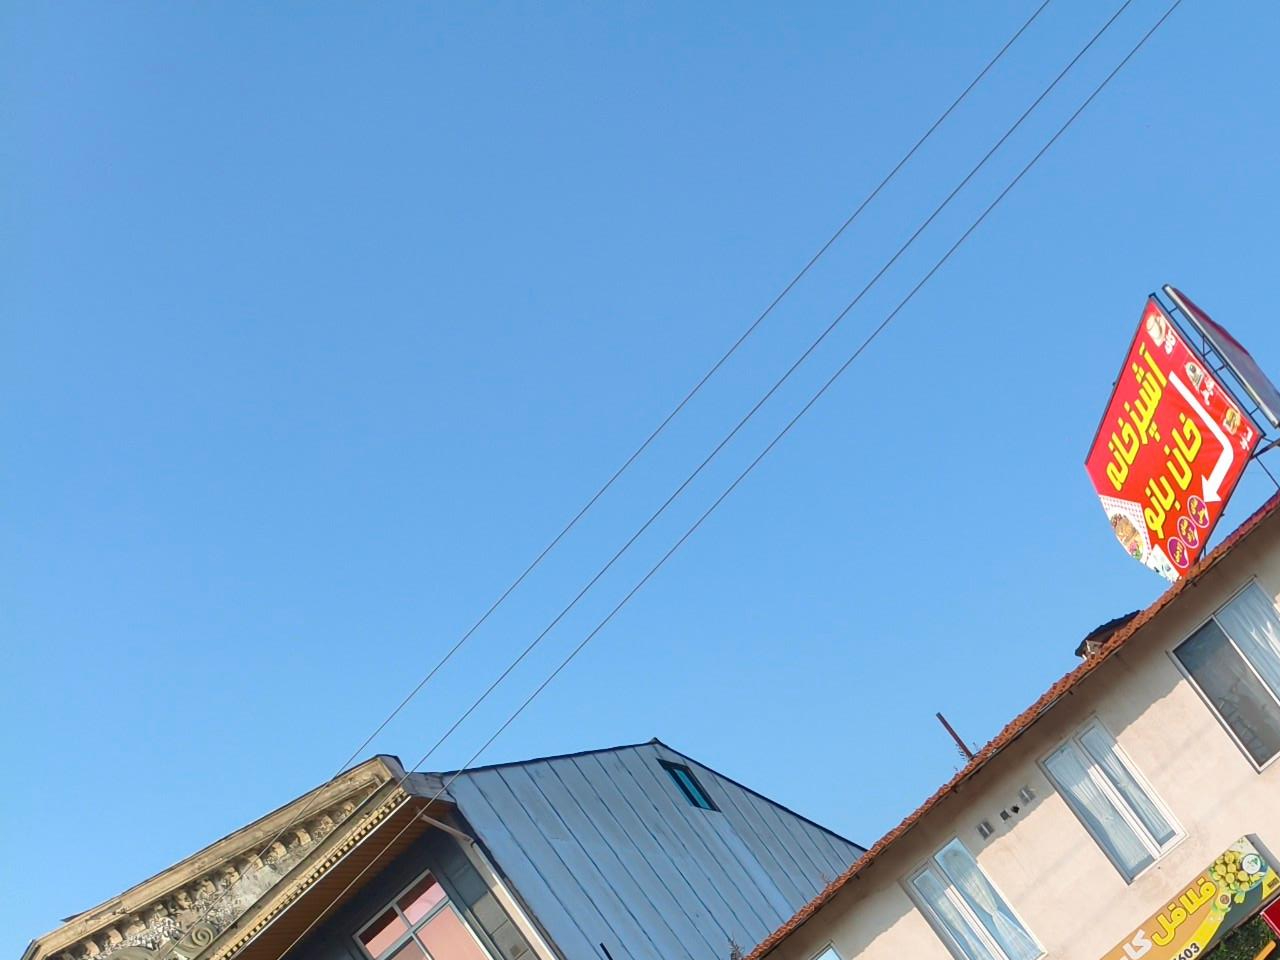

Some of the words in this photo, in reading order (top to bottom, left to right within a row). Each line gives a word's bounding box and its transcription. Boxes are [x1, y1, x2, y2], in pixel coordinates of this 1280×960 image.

[1102, 341, 1169, 491] آشپزخانه
[1163, 412, 1206, 491] خان
[1141, 475, 1180, 539] بانو
[1150, 873, 1216, 948] فلافل
